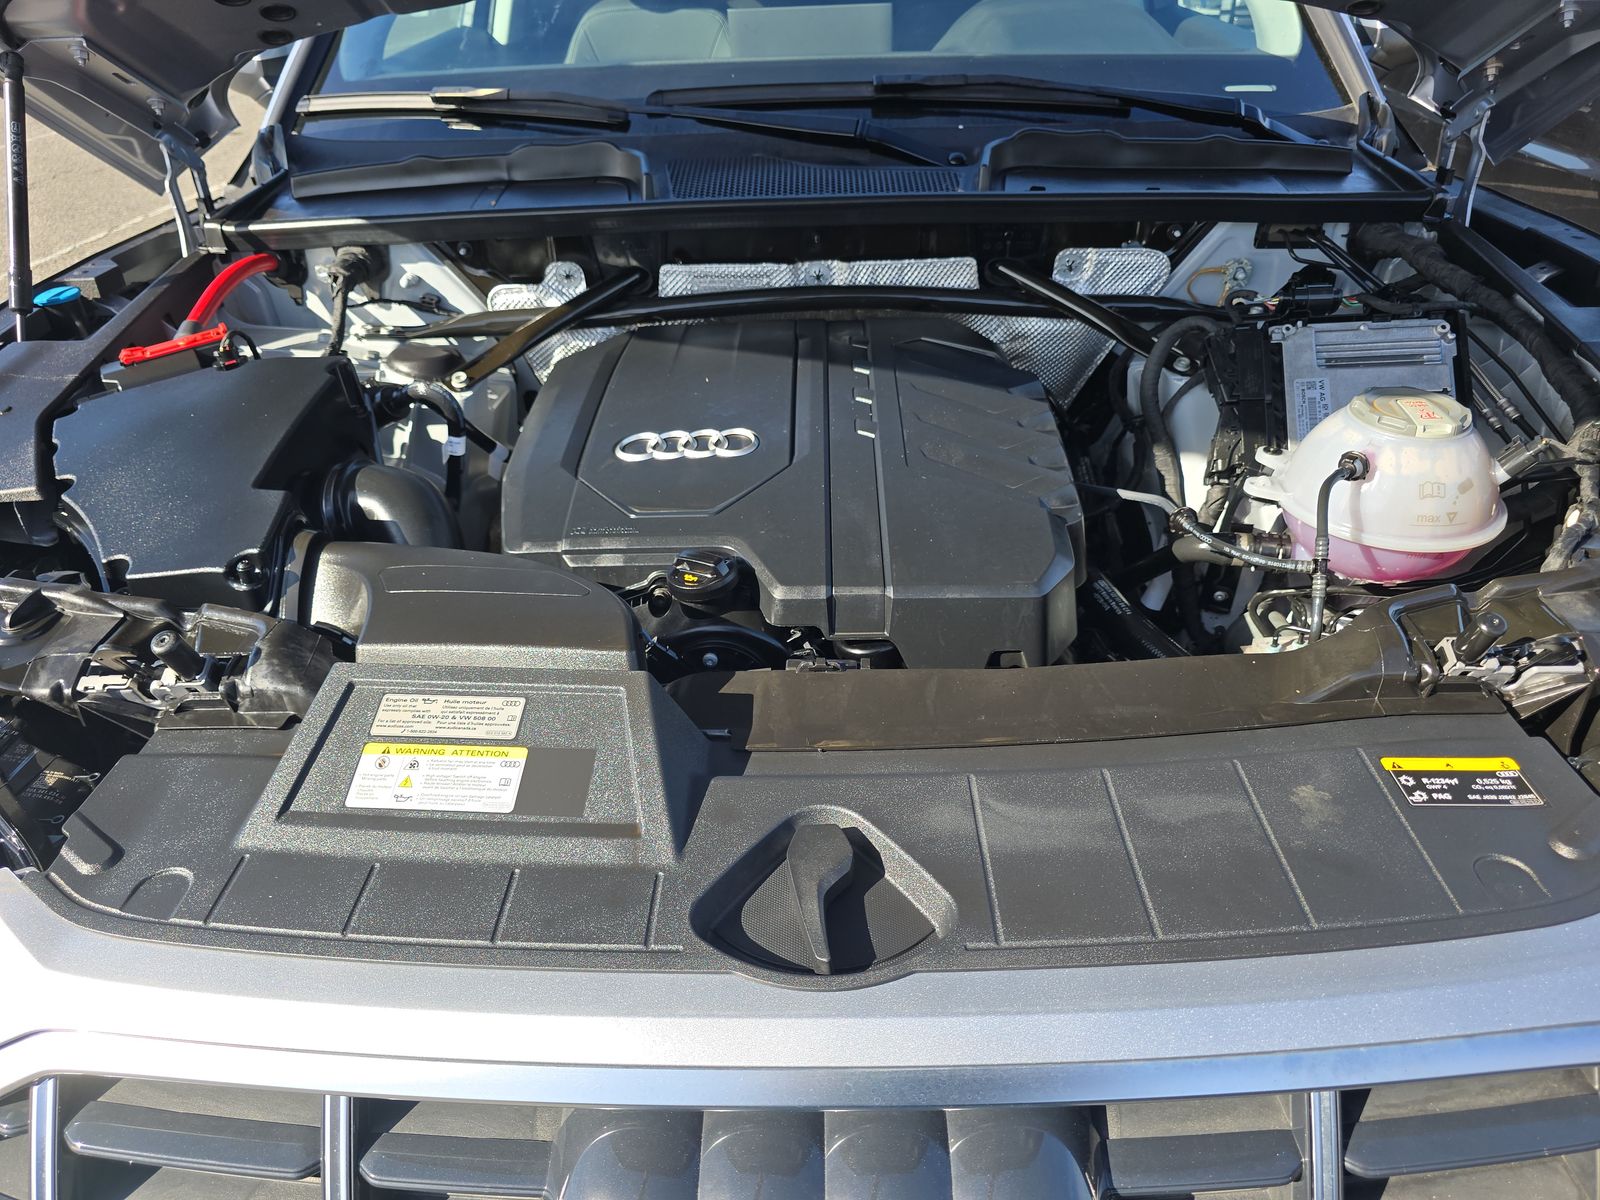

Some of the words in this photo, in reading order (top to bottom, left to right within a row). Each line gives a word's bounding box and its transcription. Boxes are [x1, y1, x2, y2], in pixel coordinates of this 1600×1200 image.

[1318, 379, 1326, 391] VW
[1319, 391, 1327, 402] AG
[1416, 514, 1441, 523] max
[395, 747, 446, 756] WARNING
[450, 749, 510, 758] ATTENTION
[1421, 777, 1459, 786] R-1234yf
[1499, 778, 1513, 786] kg
[1431, 792, 1452, 800] PAG
